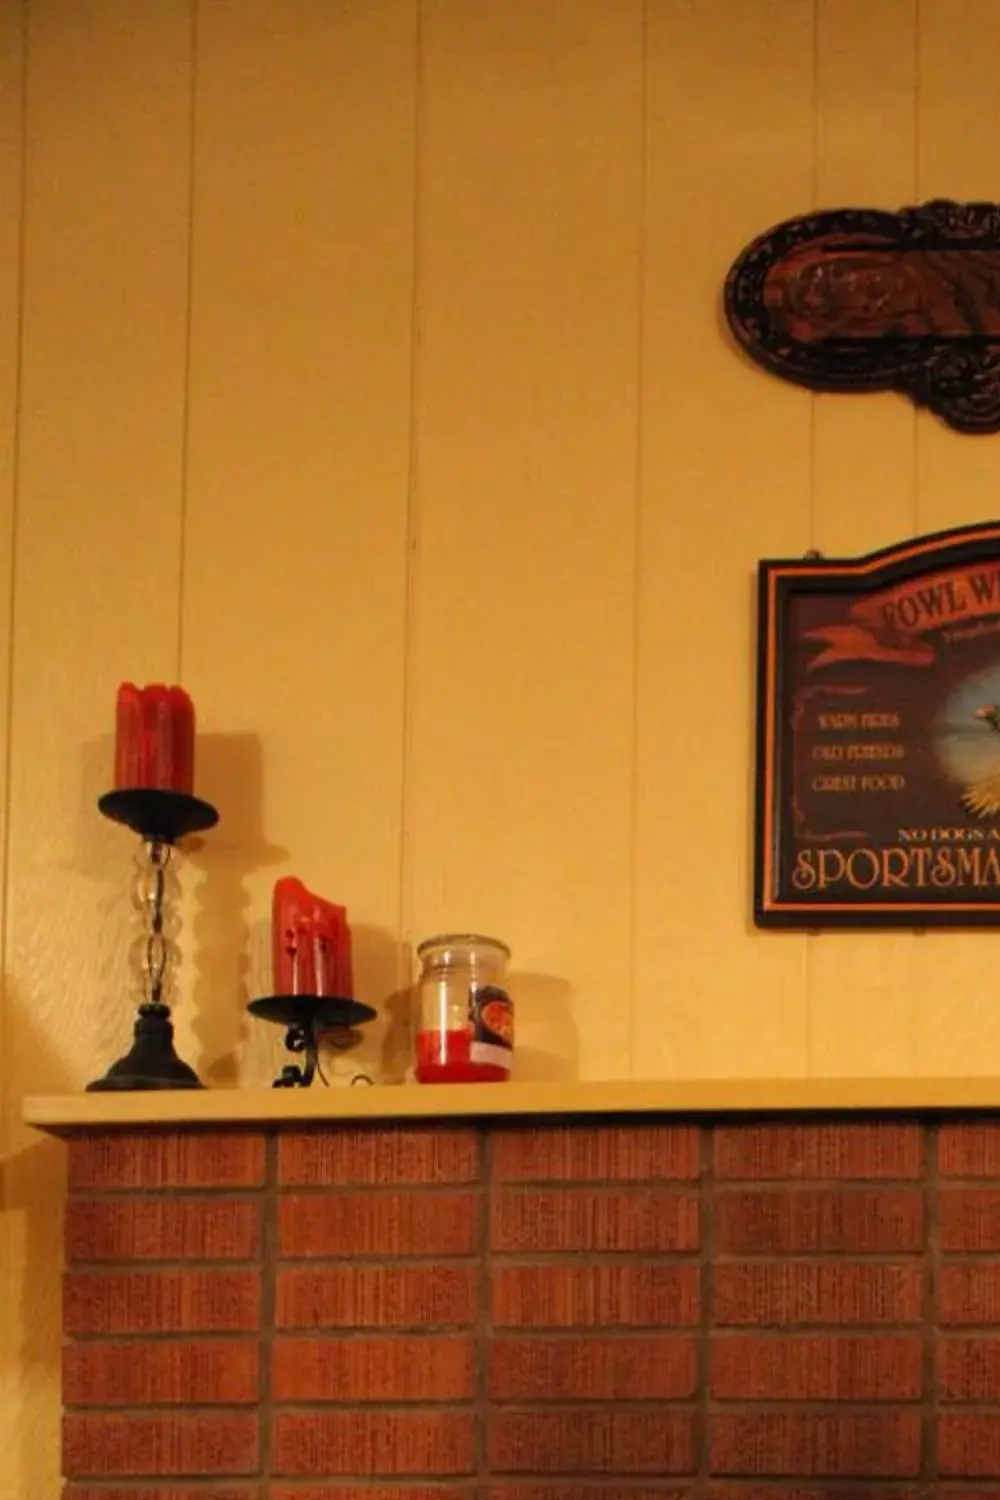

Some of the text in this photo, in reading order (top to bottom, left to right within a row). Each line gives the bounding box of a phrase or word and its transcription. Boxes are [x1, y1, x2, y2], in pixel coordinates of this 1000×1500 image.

[879, 577, 967, 629] FOWL
[861, 775, 906, 793] FOOD
[898, 827, 928, 842] NO
[930, 827, 984, 842] DOGS
